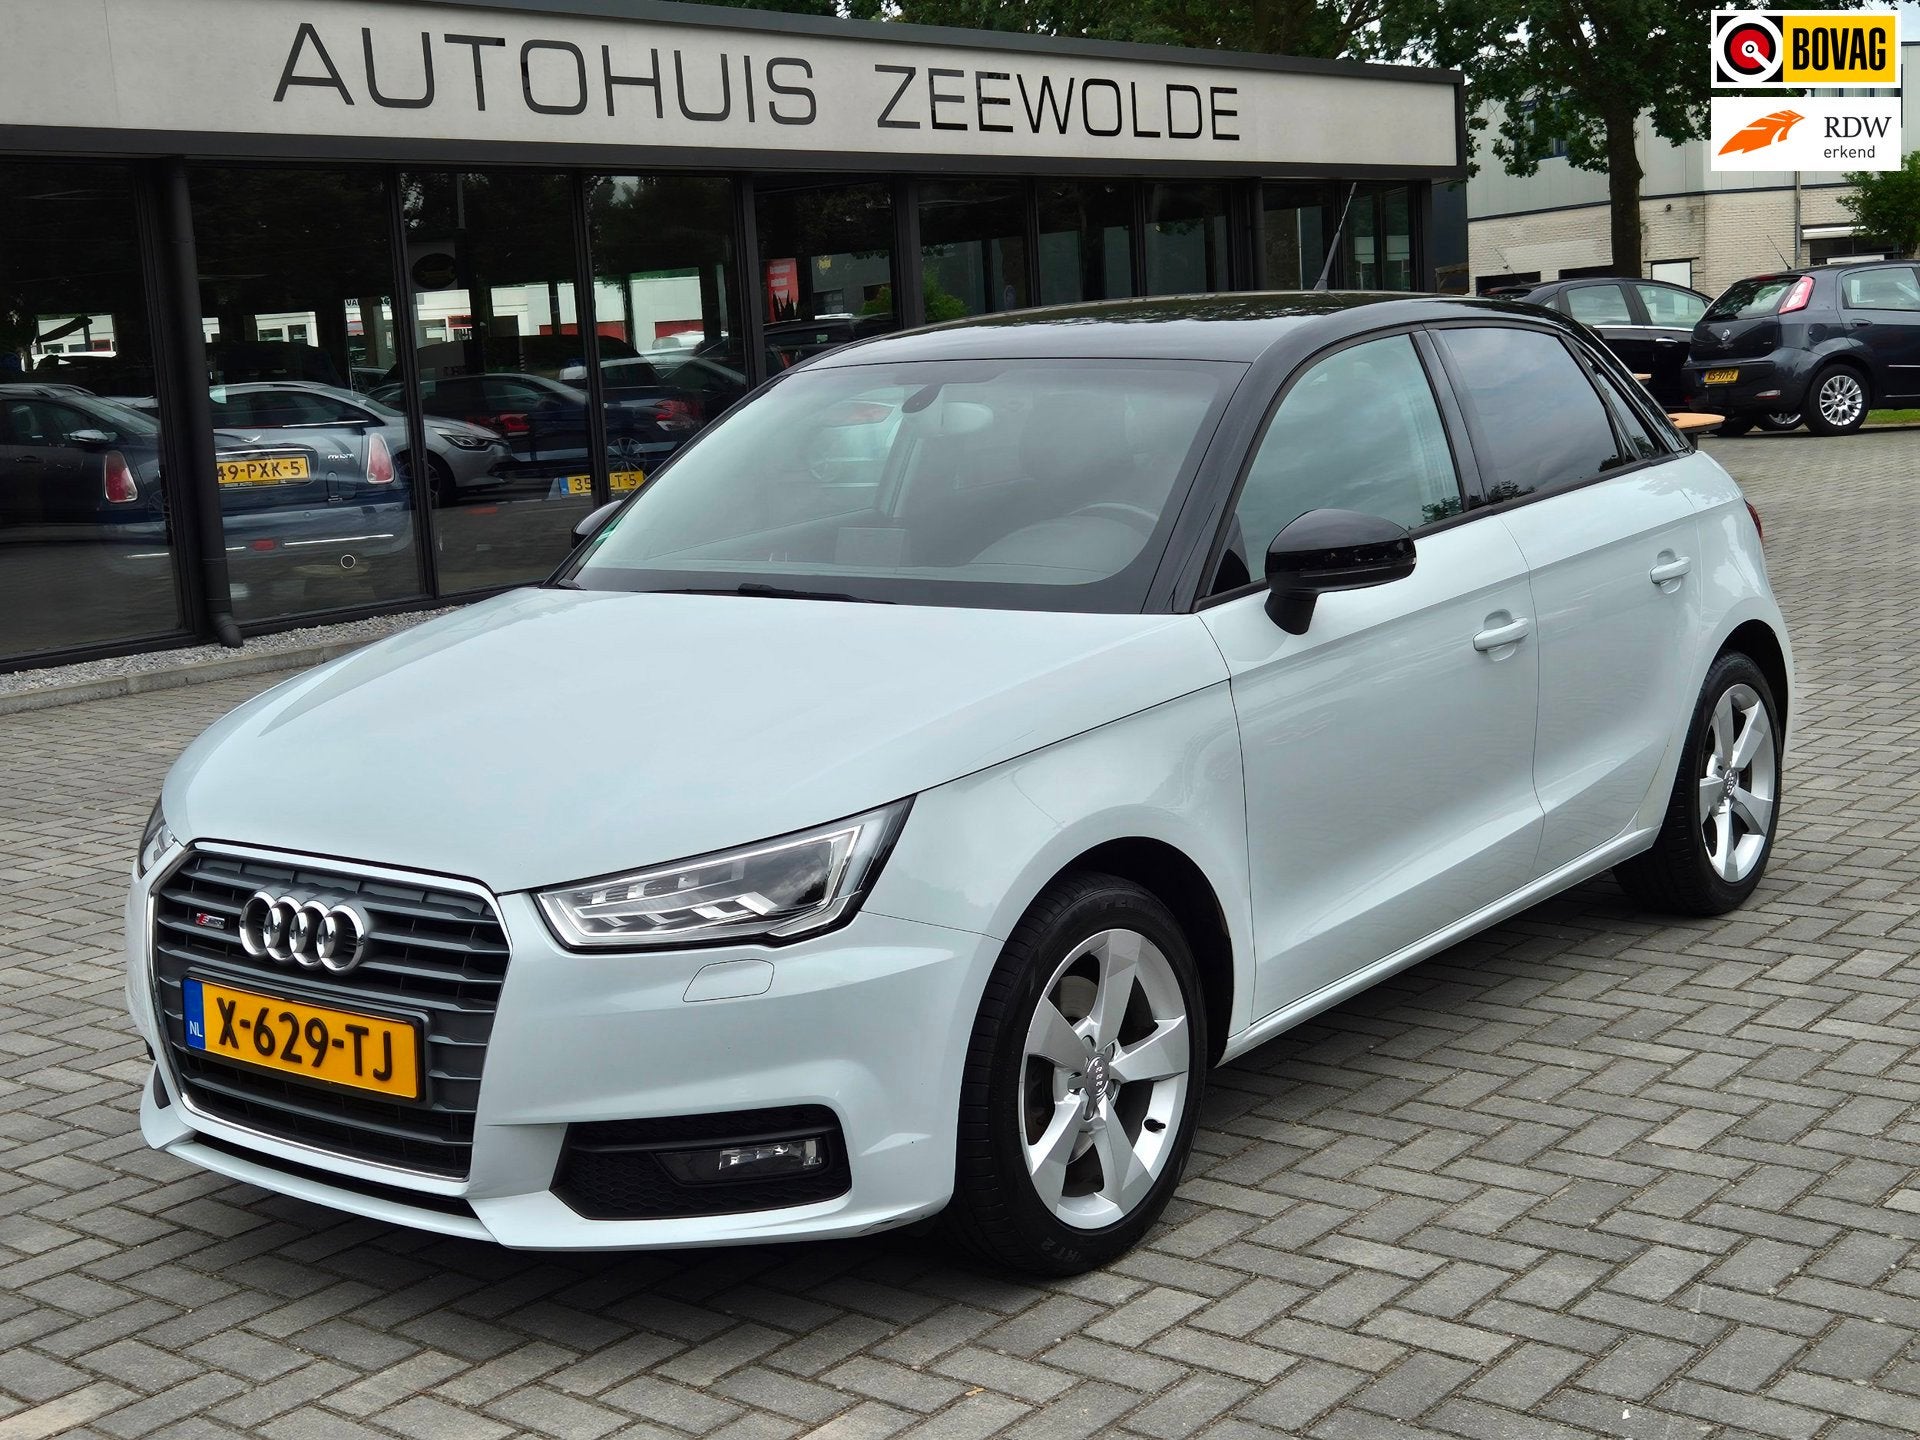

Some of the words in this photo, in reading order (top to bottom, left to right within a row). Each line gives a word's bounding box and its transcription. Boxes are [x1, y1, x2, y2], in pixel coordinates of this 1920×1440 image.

[273, 23, 817, 125] AUTOHUIS
[874, 64, 1240, 141] ZEEWOLDE
[189, 1020, 203, 1038] NL
[216, 997, 393, 1082] X-629-TJ
